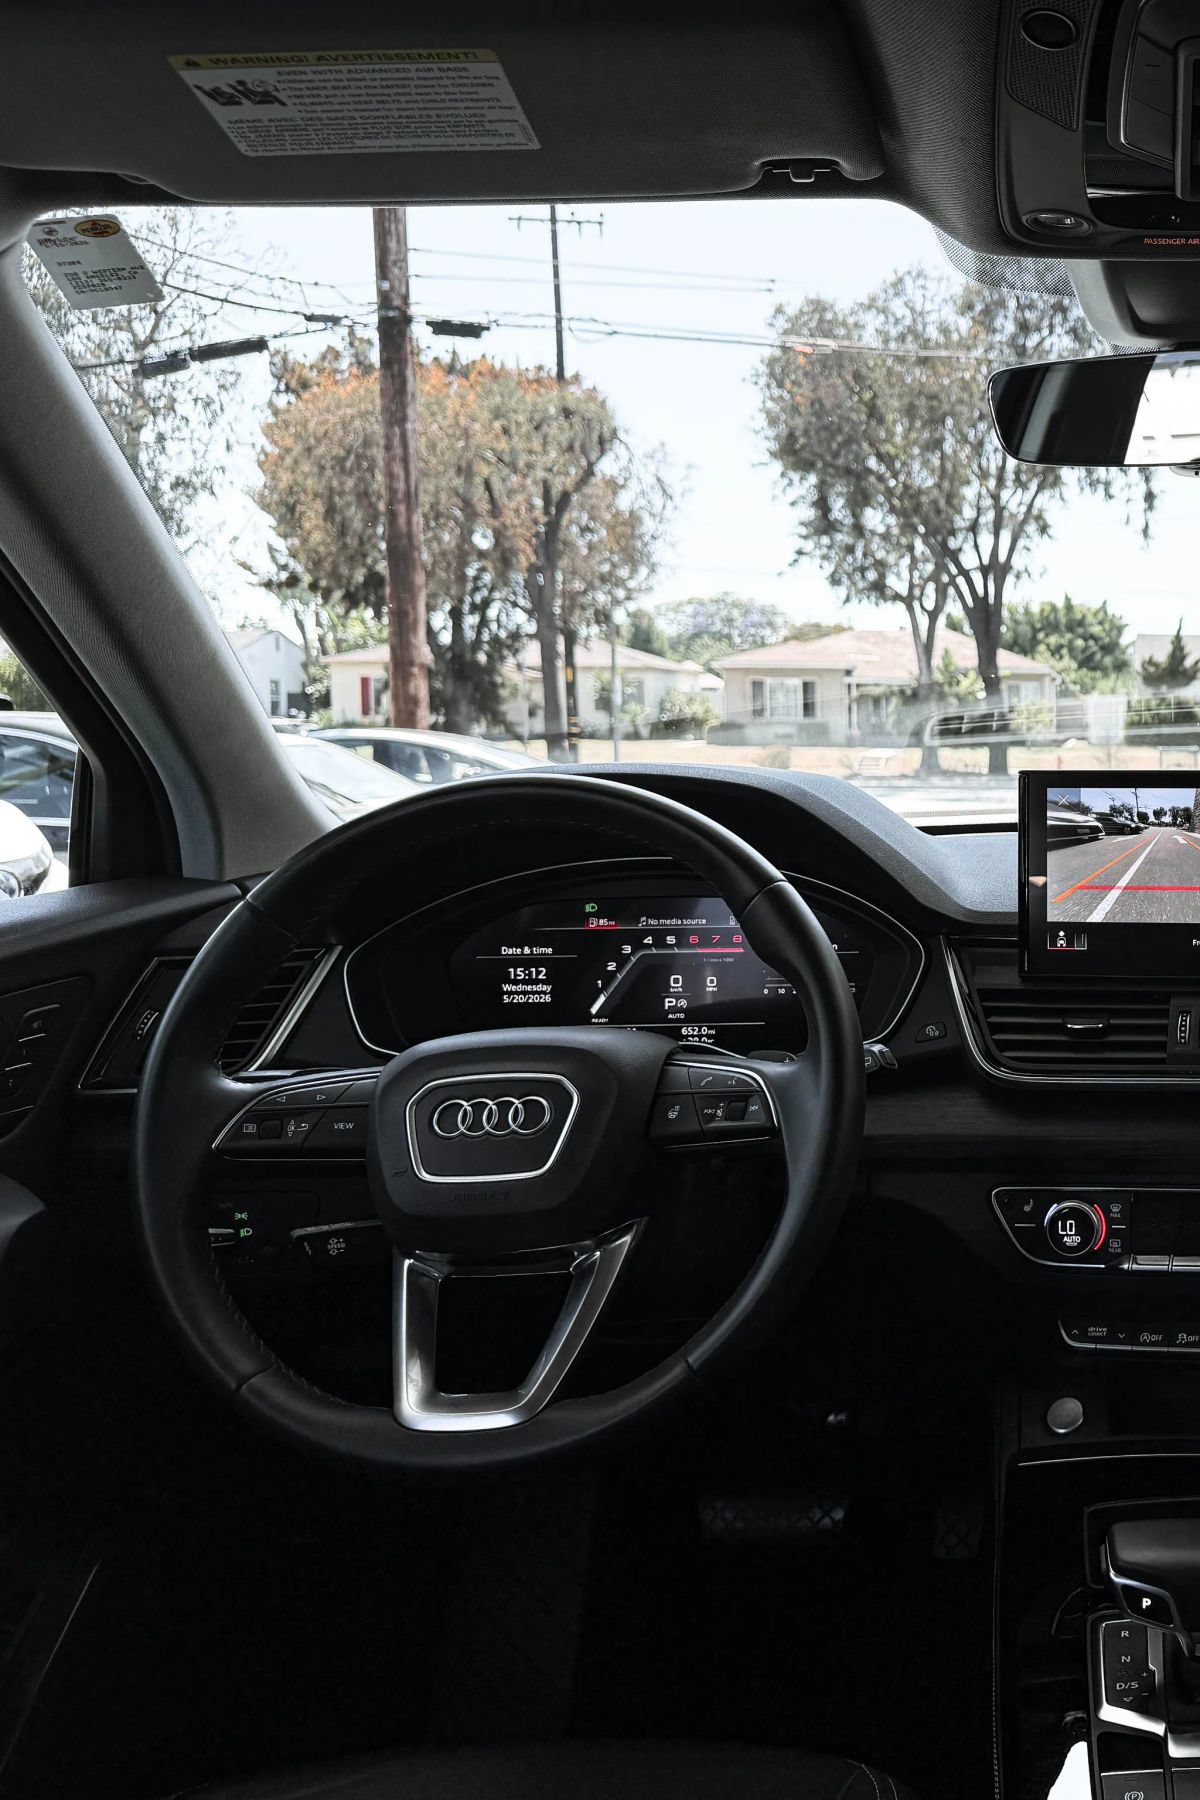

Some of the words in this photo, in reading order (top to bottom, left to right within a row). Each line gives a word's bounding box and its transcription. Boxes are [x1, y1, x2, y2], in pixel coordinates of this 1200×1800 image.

[208, 55, 310, 66] WARNING!
[316, 51, 478, 63] AVERTISSEMENT!
[642, 936, 653, 944] 4
[666, 936, 676, 944] 5
[689, 936, 699, 944] 6
[711, 935, 721, 943] 7
[732, 935, 743, 943] 8
[501, 946, 521, 955] Date
[523, 946, 531, 954] &
[533, 946, 553, 954] time
[621, 945, 632, 953] 3
[606, 962, 617, 971] 2
[507, 967, 547, 979] 15:12
[596, 980, 602, 988] 1
[670, 975, 682, 987] 0
[706, 976, 717, 987] 0
[502, 983, 552, 993] Wednesday
[502, 994, 552, 1003] 5/20/2026
[664, 998, 676, 1010] P
[287, 1124, 296, 1132] OK
[333, 1122, 355, 1130] VIEW
[1058, 1220, 1076, 1235] LO
[1150, 1334, 1164, 1342] OFF
[1141, 1597, 1152, 1609] P
[1121, 1655, 1131, 1663] N
[1115, 1681, 1139, 1690] D/S
